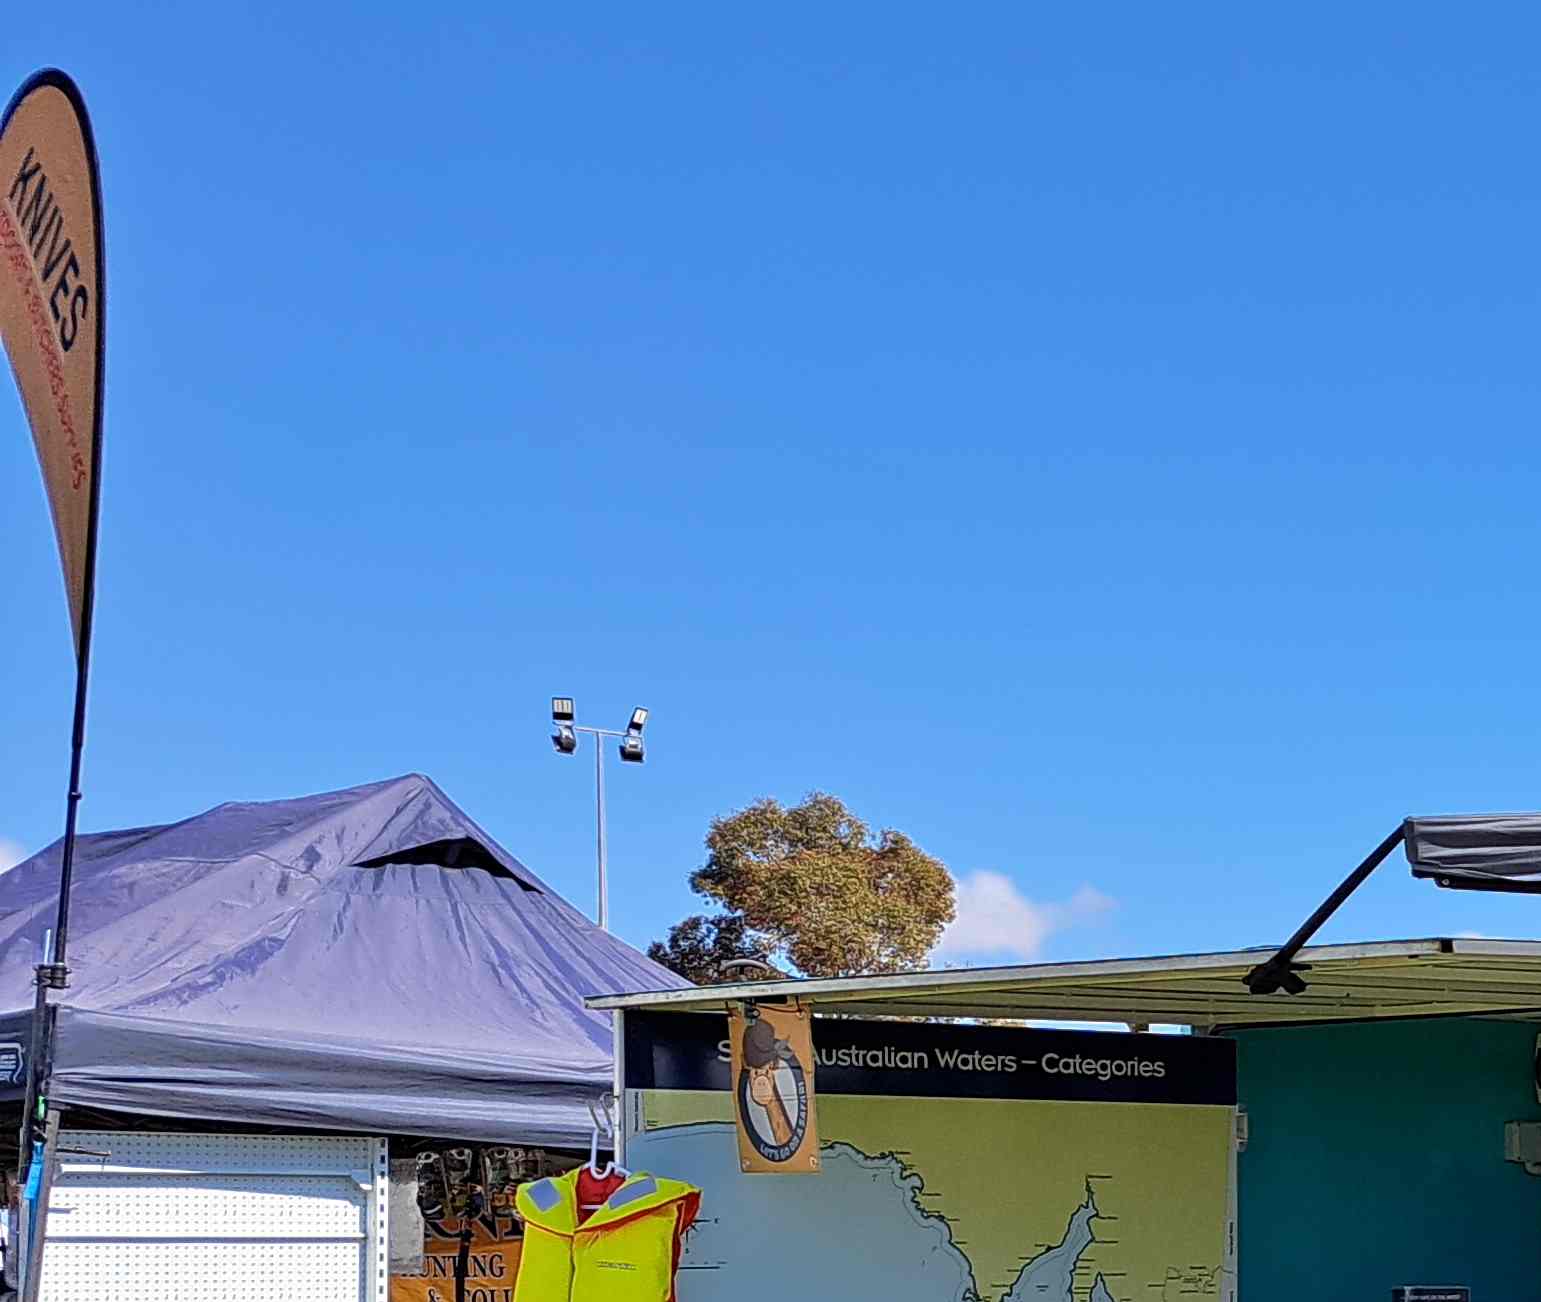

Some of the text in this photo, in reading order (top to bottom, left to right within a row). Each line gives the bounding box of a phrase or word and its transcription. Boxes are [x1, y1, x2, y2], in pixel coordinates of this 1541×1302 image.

[9, 146, 88, 353] KNIVES
[934, 1047, 1017, 1072] Waters
[1041, 1053, 1167, 1080] Categories
